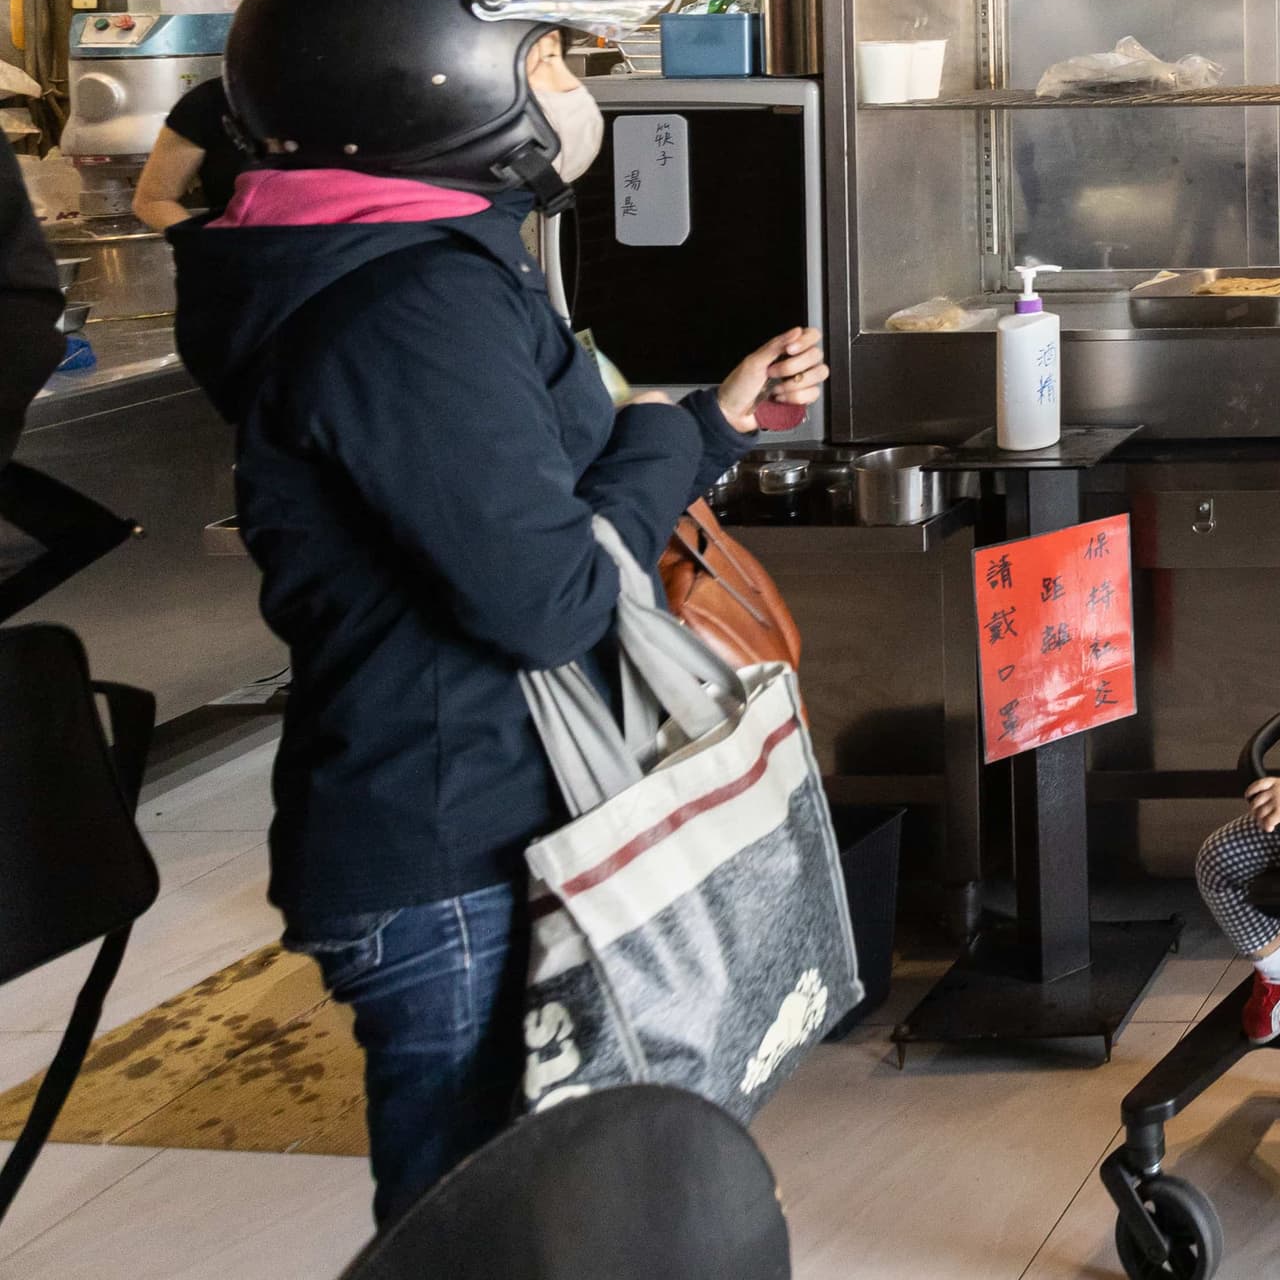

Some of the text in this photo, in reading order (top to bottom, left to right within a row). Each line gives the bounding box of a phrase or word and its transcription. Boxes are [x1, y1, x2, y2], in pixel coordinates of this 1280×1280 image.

[655, 123, 674, 166] 筷子
[984, 553, 1020, 742] 請戴口罩
[1040, 575, 1073, 656] 距離
[1084, 532, 1119, 708] 保持社交
